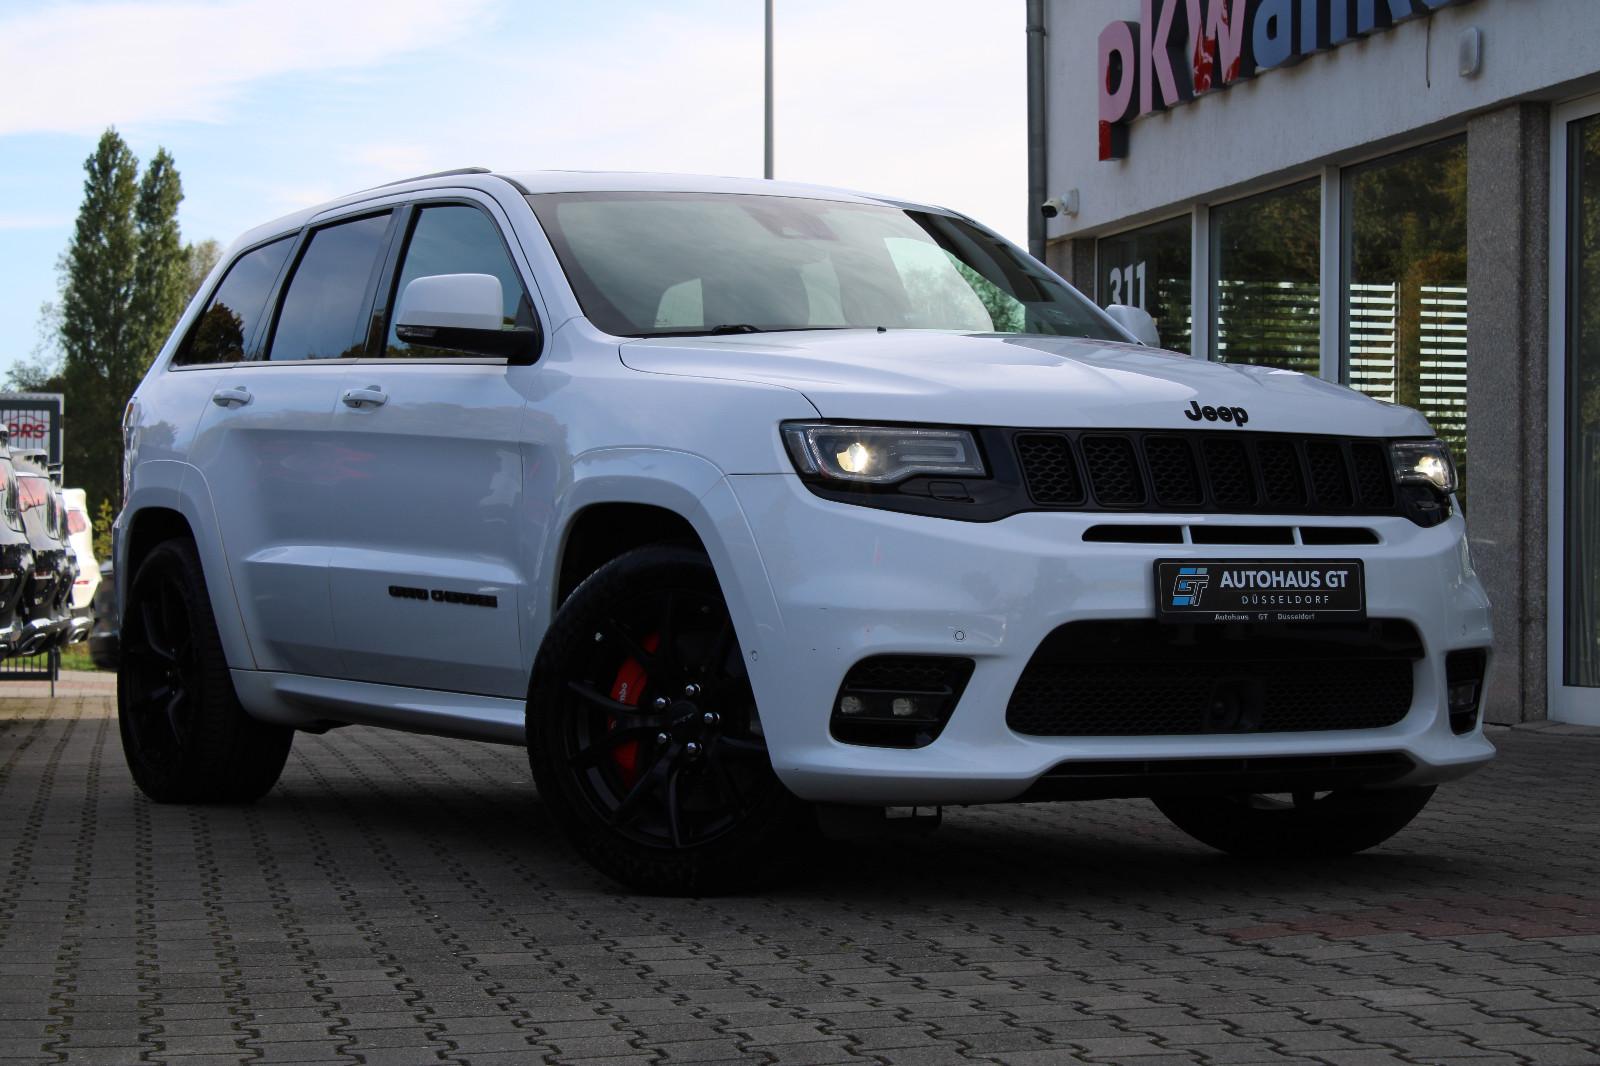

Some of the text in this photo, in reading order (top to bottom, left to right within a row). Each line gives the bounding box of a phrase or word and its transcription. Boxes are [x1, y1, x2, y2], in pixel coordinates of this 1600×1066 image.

[1109, 261, 1146, 310] 311
[1184, 400, 1249, 427] Jeep
[1220, 570, 1349, 588] AUTOHAUS GT
[1241, 593, 1330, 605] DÜSSELDORF
[1214, 612, 1316, 621] Autohaus GT Düsseldorf
